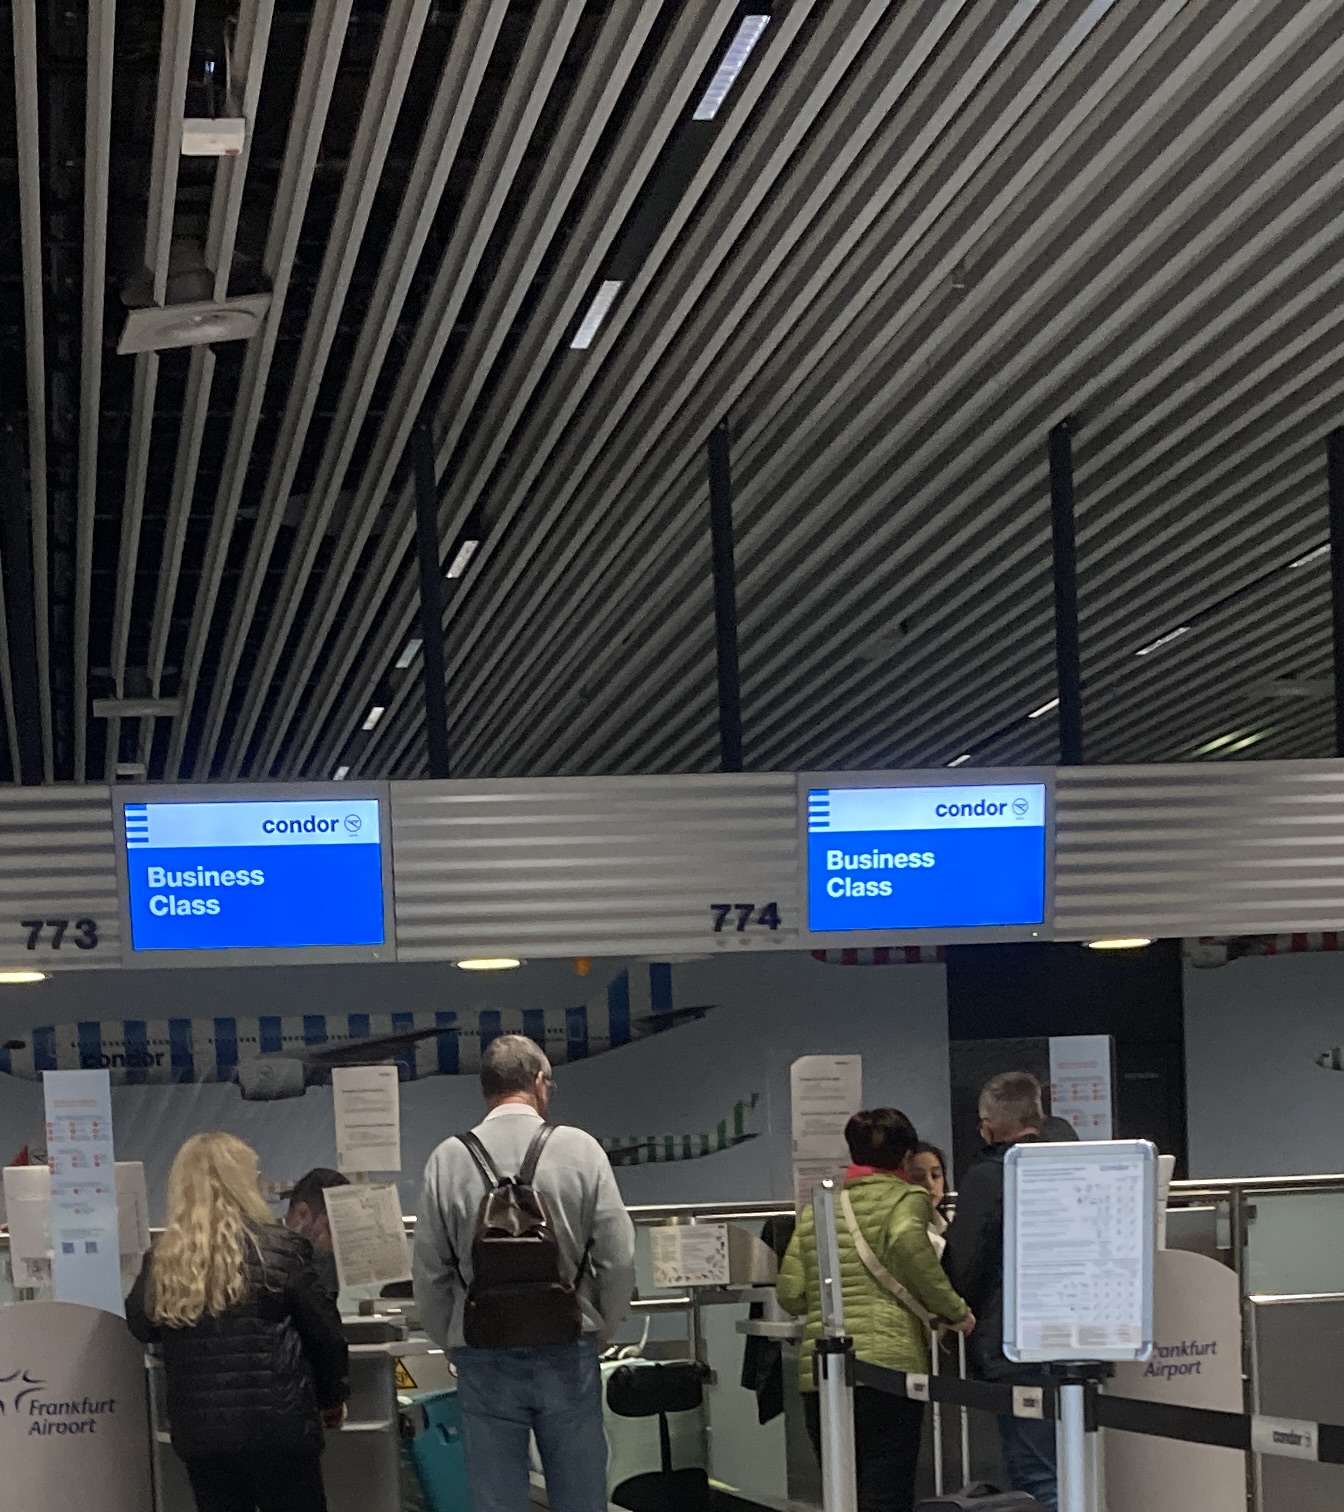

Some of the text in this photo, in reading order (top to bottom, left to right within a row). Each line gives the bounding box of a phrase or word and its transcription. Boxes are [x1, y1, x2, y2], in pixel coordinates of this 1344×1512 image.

[935, 800, 1007, 818] condor
[262, 815, 339, 834] condor
[826, 849, 935, 871] Business
[147, 866, 265, 889] Business
[826, 877, 893, 898] Class
[149, 894, 221, 916] Class
[711, 902, 782, 932] 774
[21, 918, 99, 950] 773
[1153, 1340, 1217, 1358] rankfurt
[1143, 1361, 1201, 1381] Airport
[29, 1397, 116, 1416] Frankfurt
[29, 1418, 97, 1436] Airport
